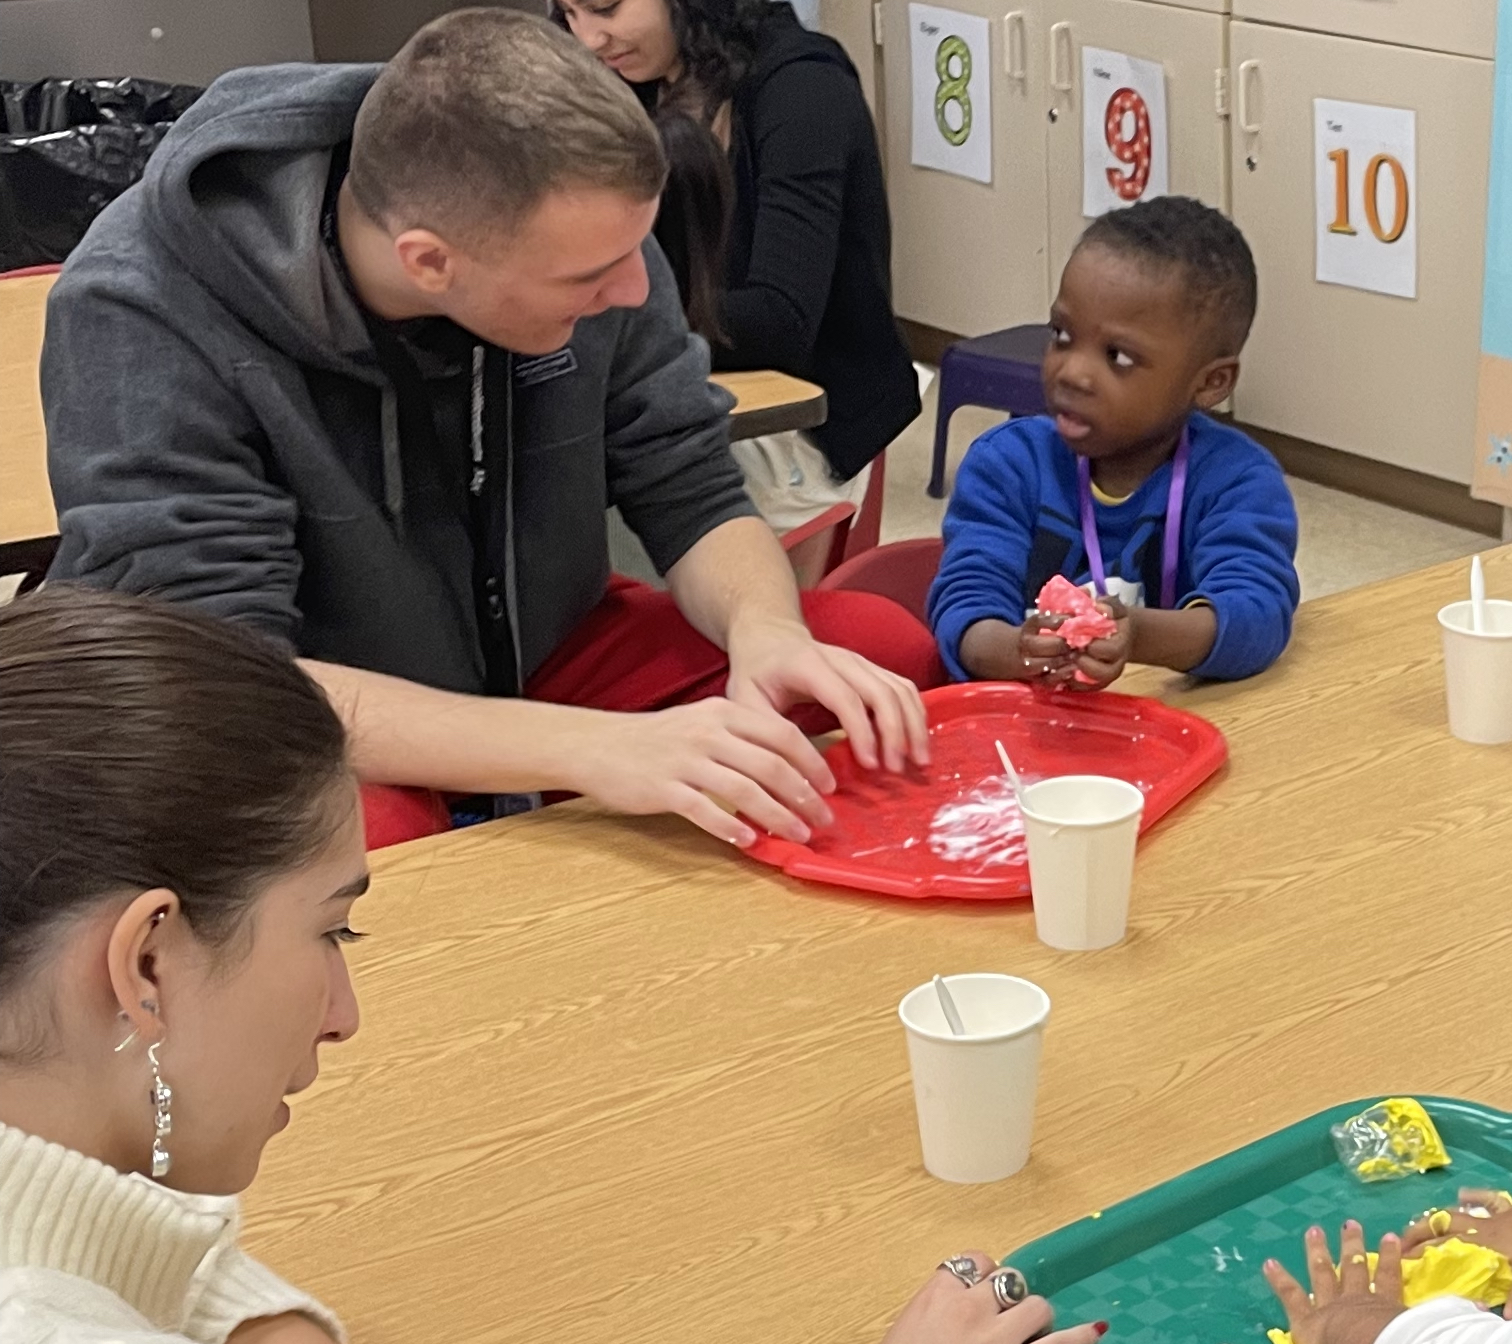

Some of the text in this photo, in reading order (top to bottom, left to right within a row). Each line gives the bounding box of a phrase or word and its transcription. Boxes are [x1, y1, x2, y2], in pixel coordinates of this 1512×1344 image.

[935, 34, 972, 147] 8
[1104, 87, 1152, 202] 9
[1327, 148, 1409, 244] 10
